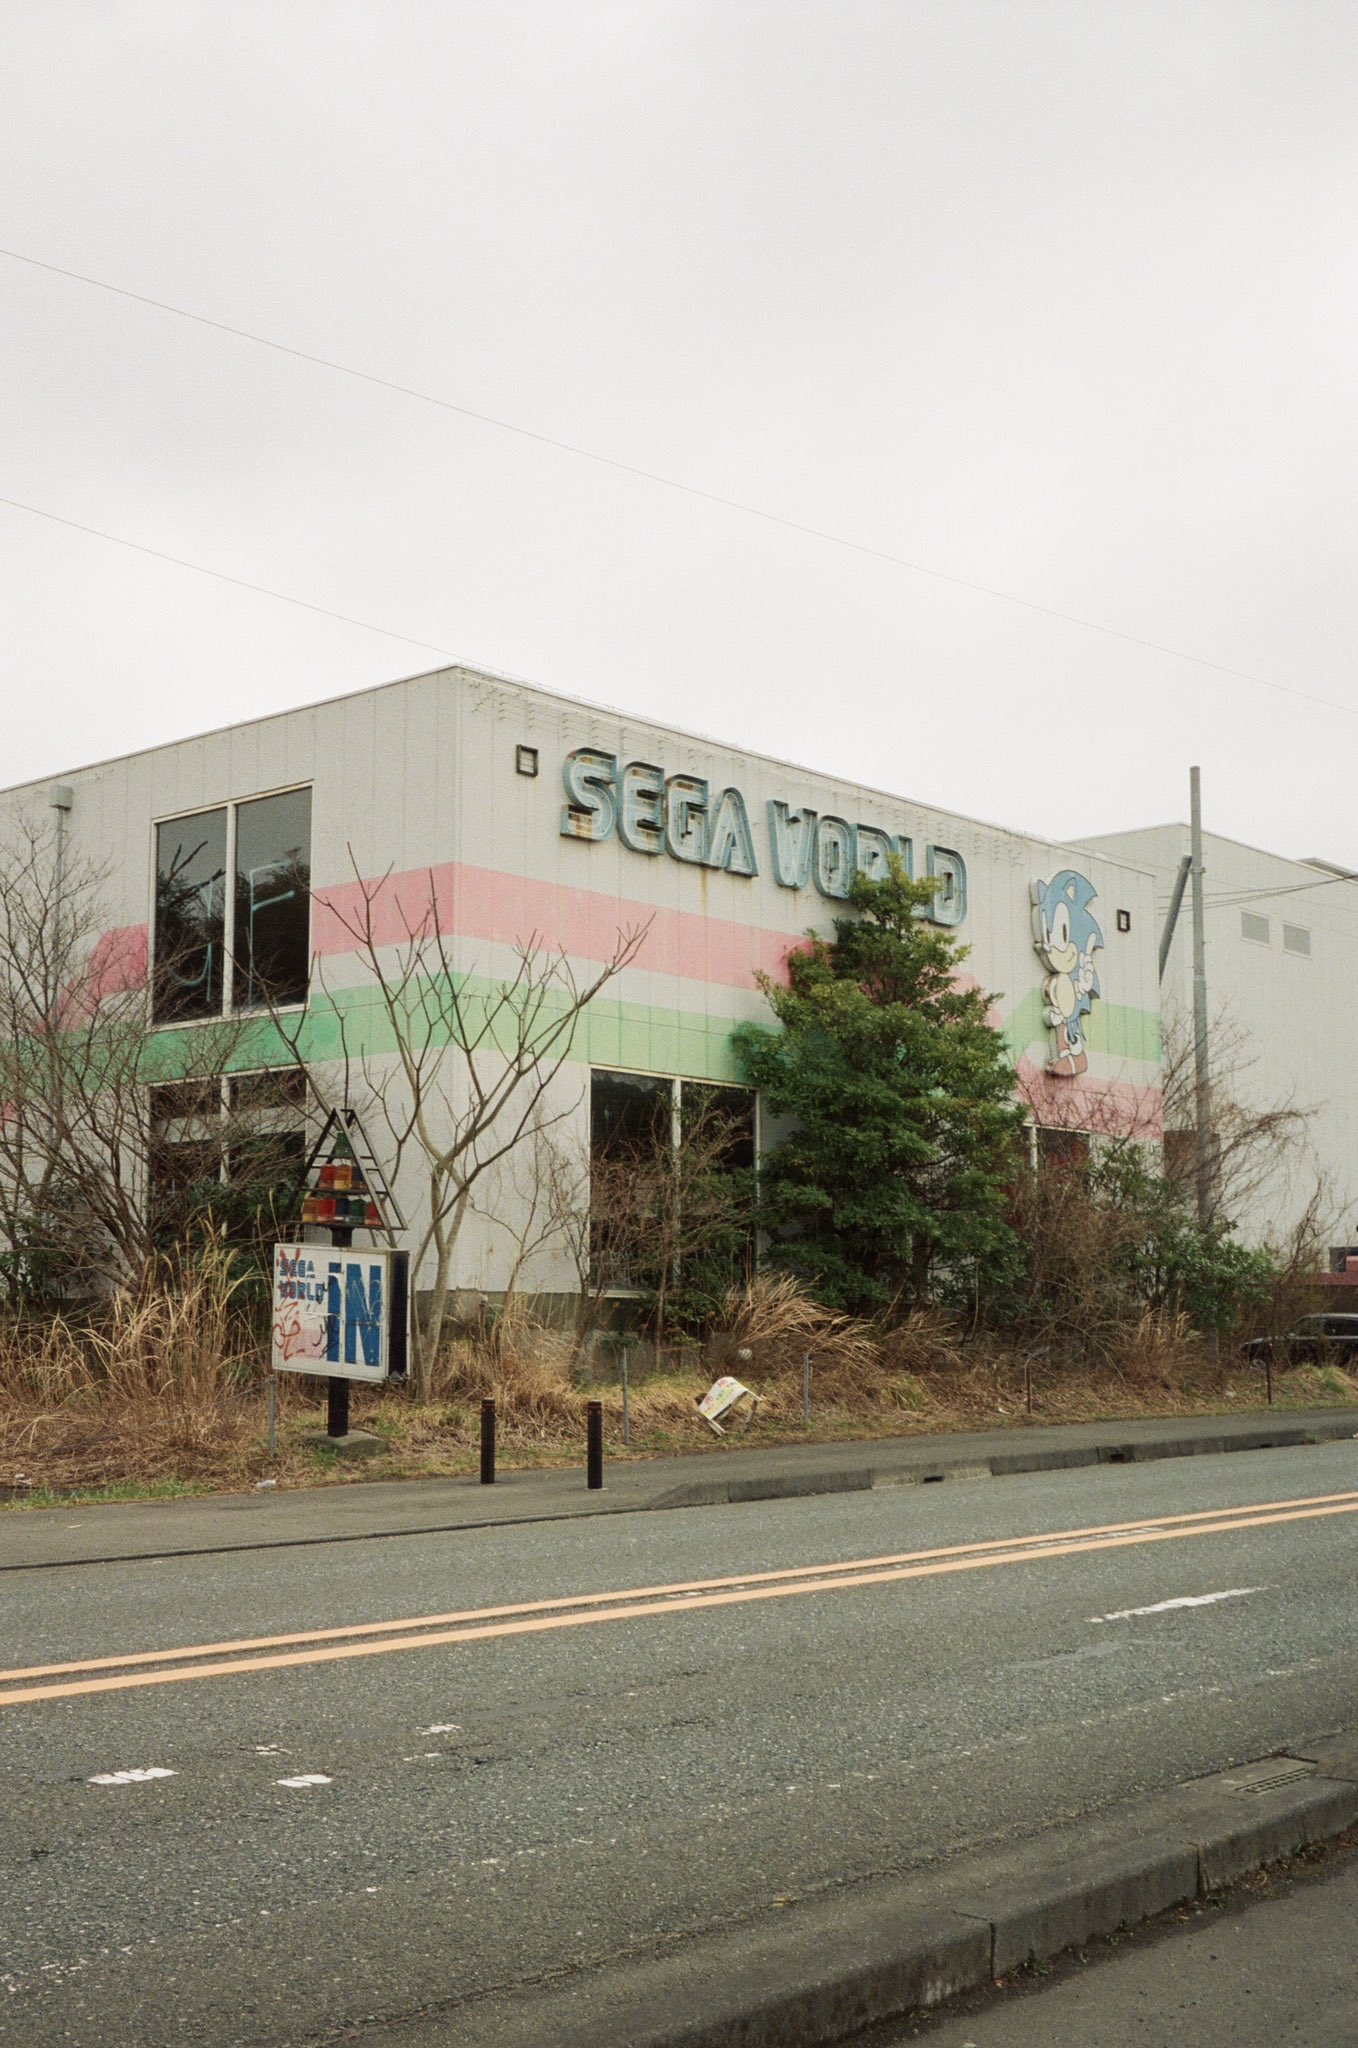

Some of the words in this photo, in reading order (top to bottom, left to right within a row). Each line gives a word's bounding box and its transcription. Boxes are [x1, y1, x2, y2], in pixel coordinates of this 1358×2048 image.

[560, 747, 758, 877] SEGA
[280, 1259, 315, 1279] SEGA
[280, 1280, 324, 1302] WORLD
[327, 1262, 382, 1367] IN
